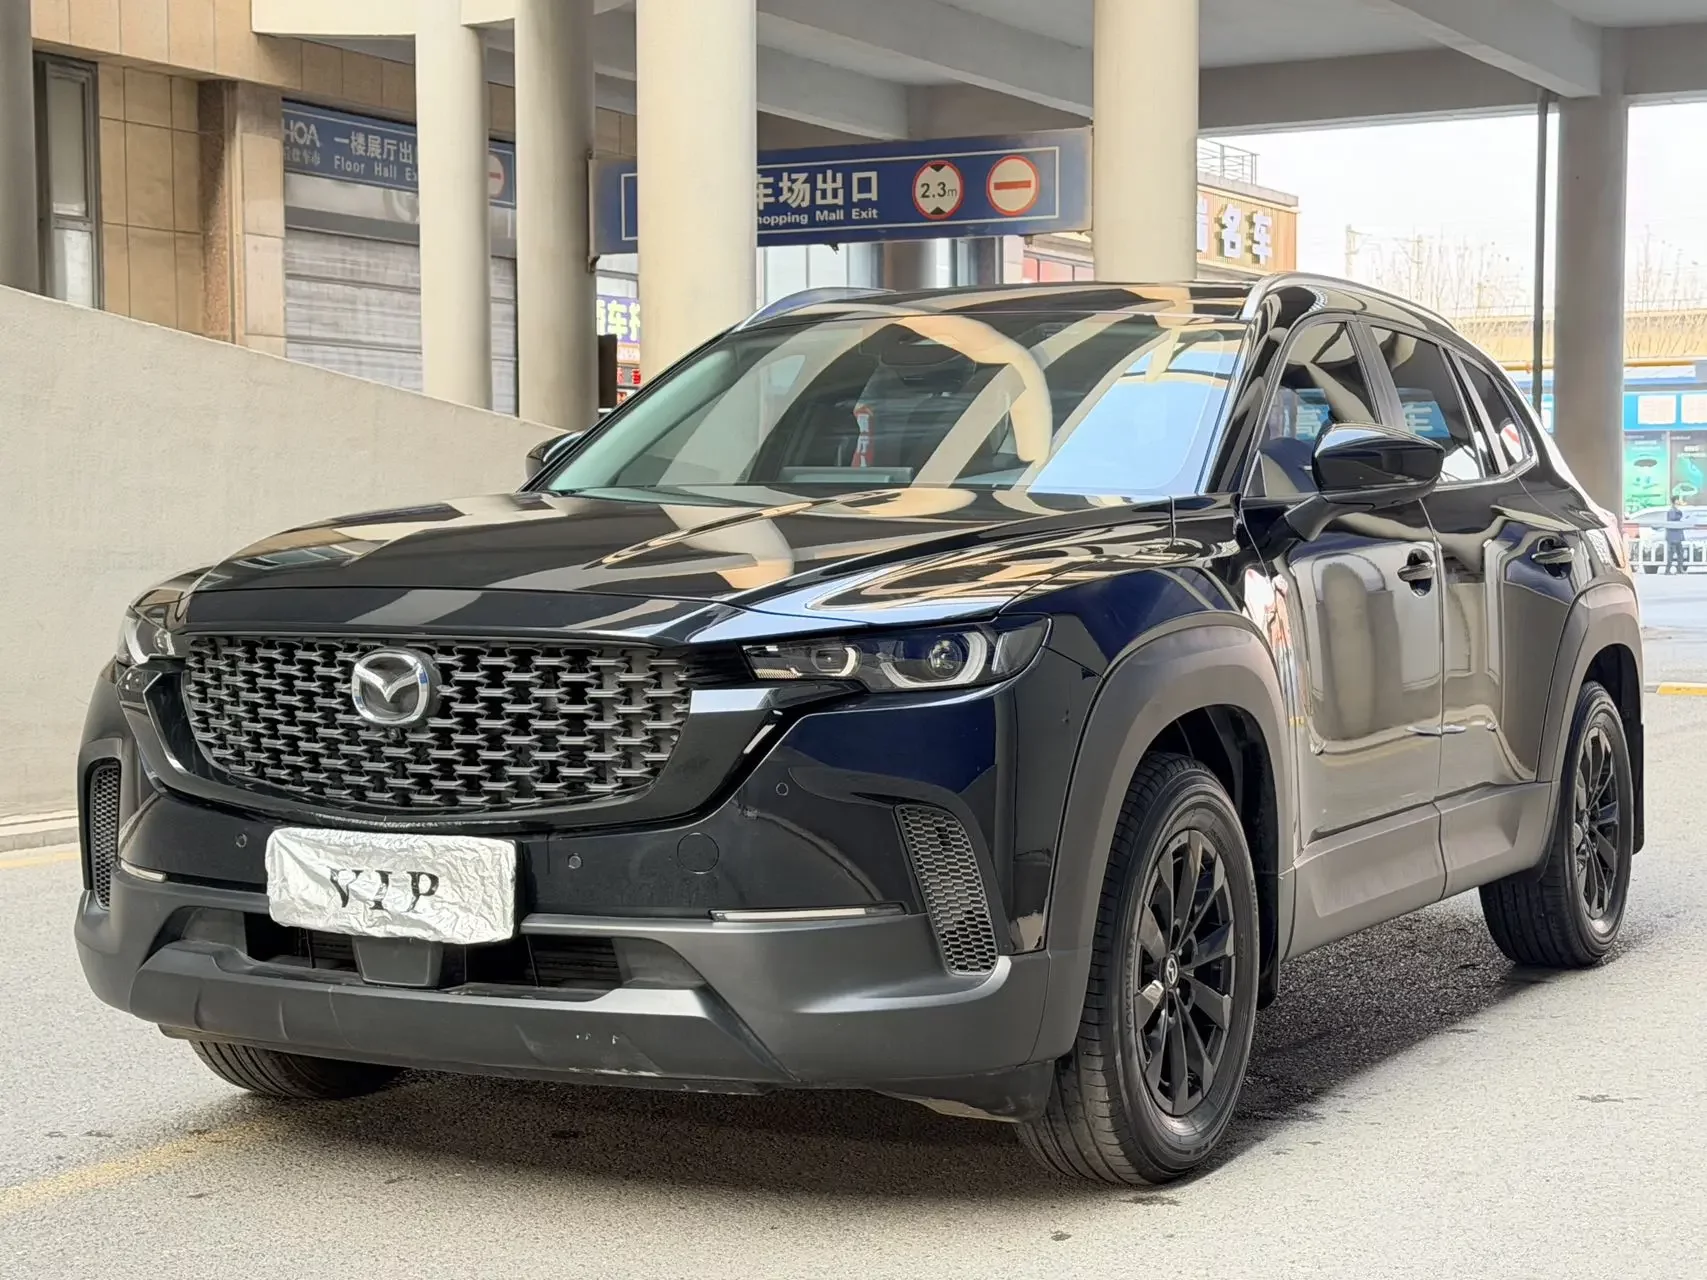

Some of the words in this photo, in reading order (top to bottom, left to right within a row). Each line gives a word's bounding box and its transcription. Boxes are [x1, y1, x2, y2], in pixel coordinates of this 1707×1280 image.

[334, 131, 418, 164] 一楼展厅出
[334, 155, 365, 174] Floor
[374, 162, 397, 180] Hall
[757, 169, 878, 210] 车场出口
[815, 209, 844, 222] Mall
[851, 207, 878, 220] Exit
[327, 866, 439, 913] VIP
